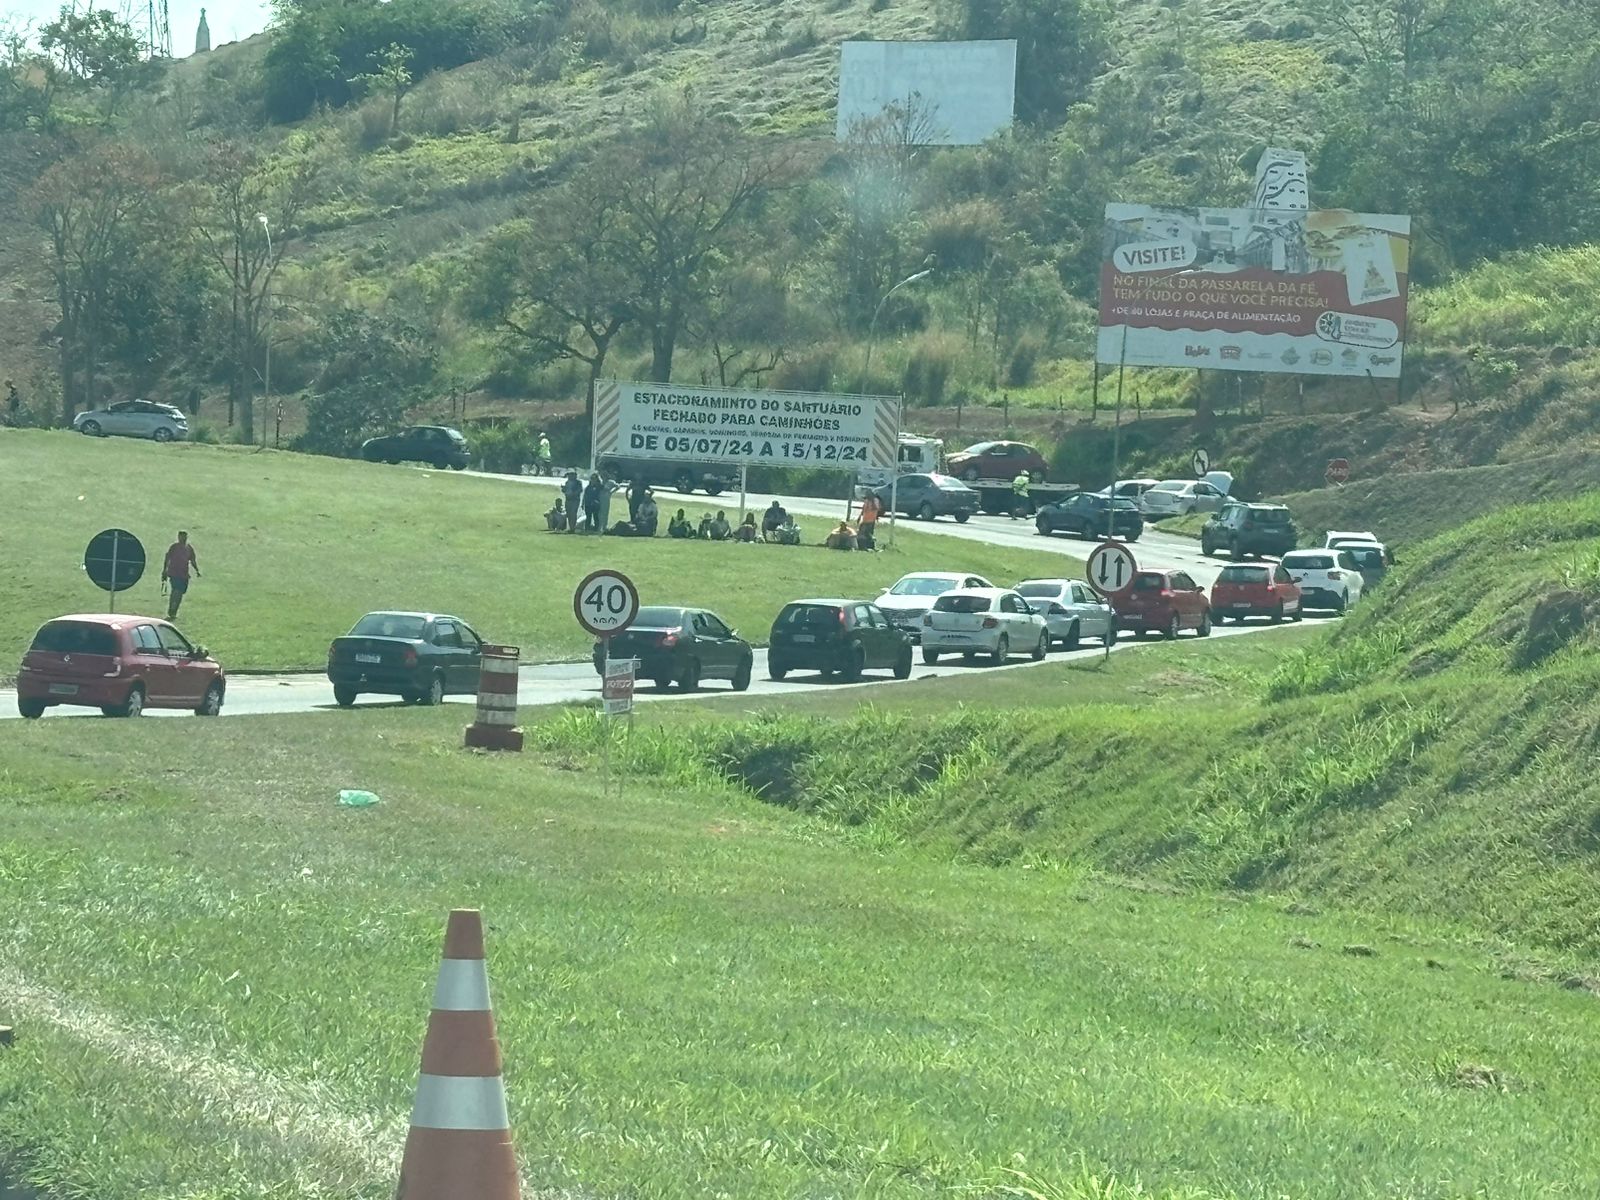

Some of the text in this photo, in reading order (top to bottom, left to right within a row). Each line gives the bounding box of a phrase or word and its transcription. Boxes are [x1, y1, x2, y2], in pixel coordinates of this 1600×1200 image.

[1122, 246, 1186, 266] VISITE!
[1113, 275, 1134, 287] NO
[1138, 276, 1175, 289] FINAL
[1178, 278, 1198, 289] DA
[1201, 279, 1275, 292] PASSARELA
[1278, 282, 1296, 293] DA
[1113, 288, 1329, 308] TEM TUDO O QUE VOCÊ PRECISA!
[1145, 308, 1173, 317] LOJAS
[1175, 309, 1180, 318] E
[1183, 310, 1215, 320] PRAÇA
[1217, 311, 1229, 319] DE
[1232, 312, 1301, 323] ALIMENTAÇÃO
[633, 392, 862, 416] ESTACIONAMENTO DO SANTUÁRIO
[653, 409, 841, 430] FECHADO PARA CAMINHÕES
[630, 433, 868, 462] DE 05/07/24 A 15/12/24
[584, 584, 627, 614] 40
